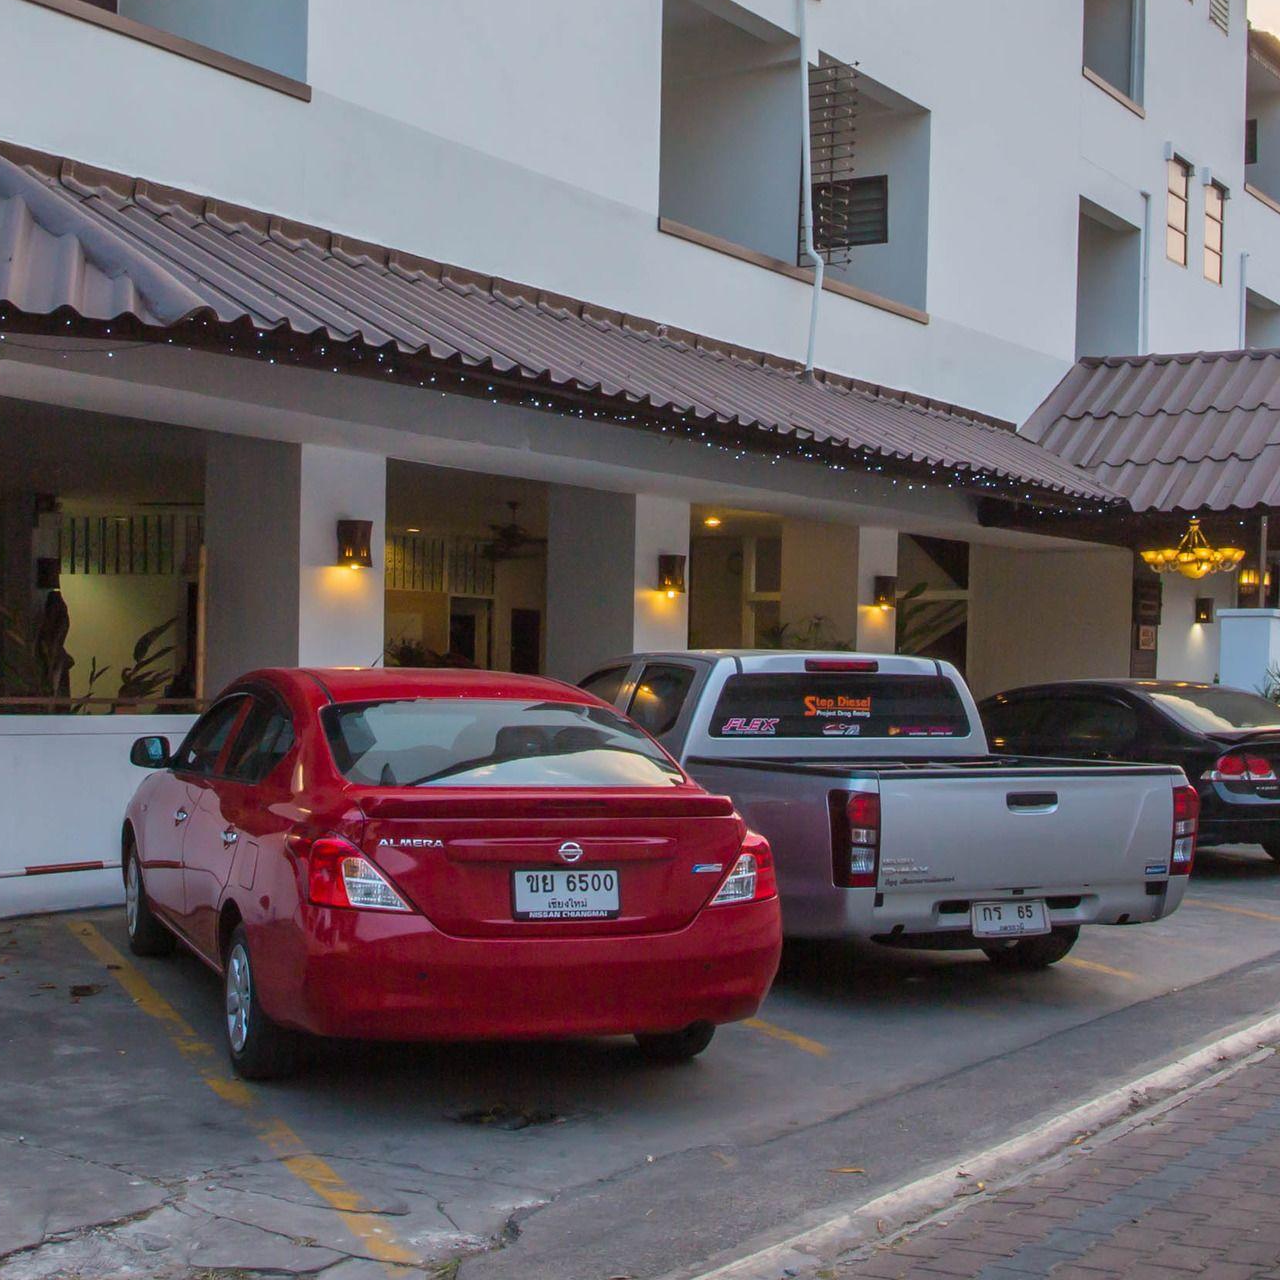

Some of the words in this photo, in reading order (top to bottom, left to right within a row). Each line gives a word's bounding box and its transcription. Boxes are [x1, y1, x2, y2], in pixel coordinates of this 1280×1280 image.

[837, 695, 871, 707] Diesel
[722, 717, 780, 732] FLEX
[378, 838, 444, 848] ALMERA
[566, 874, 614, 892] 6500
[548, 898, 587, 909] เชียงใหม่
[529, 911, 560, 919] NISSAN
[562, 910, 608, 918] CHIANGMAI
[1017, 905, 1033, 919] 65
